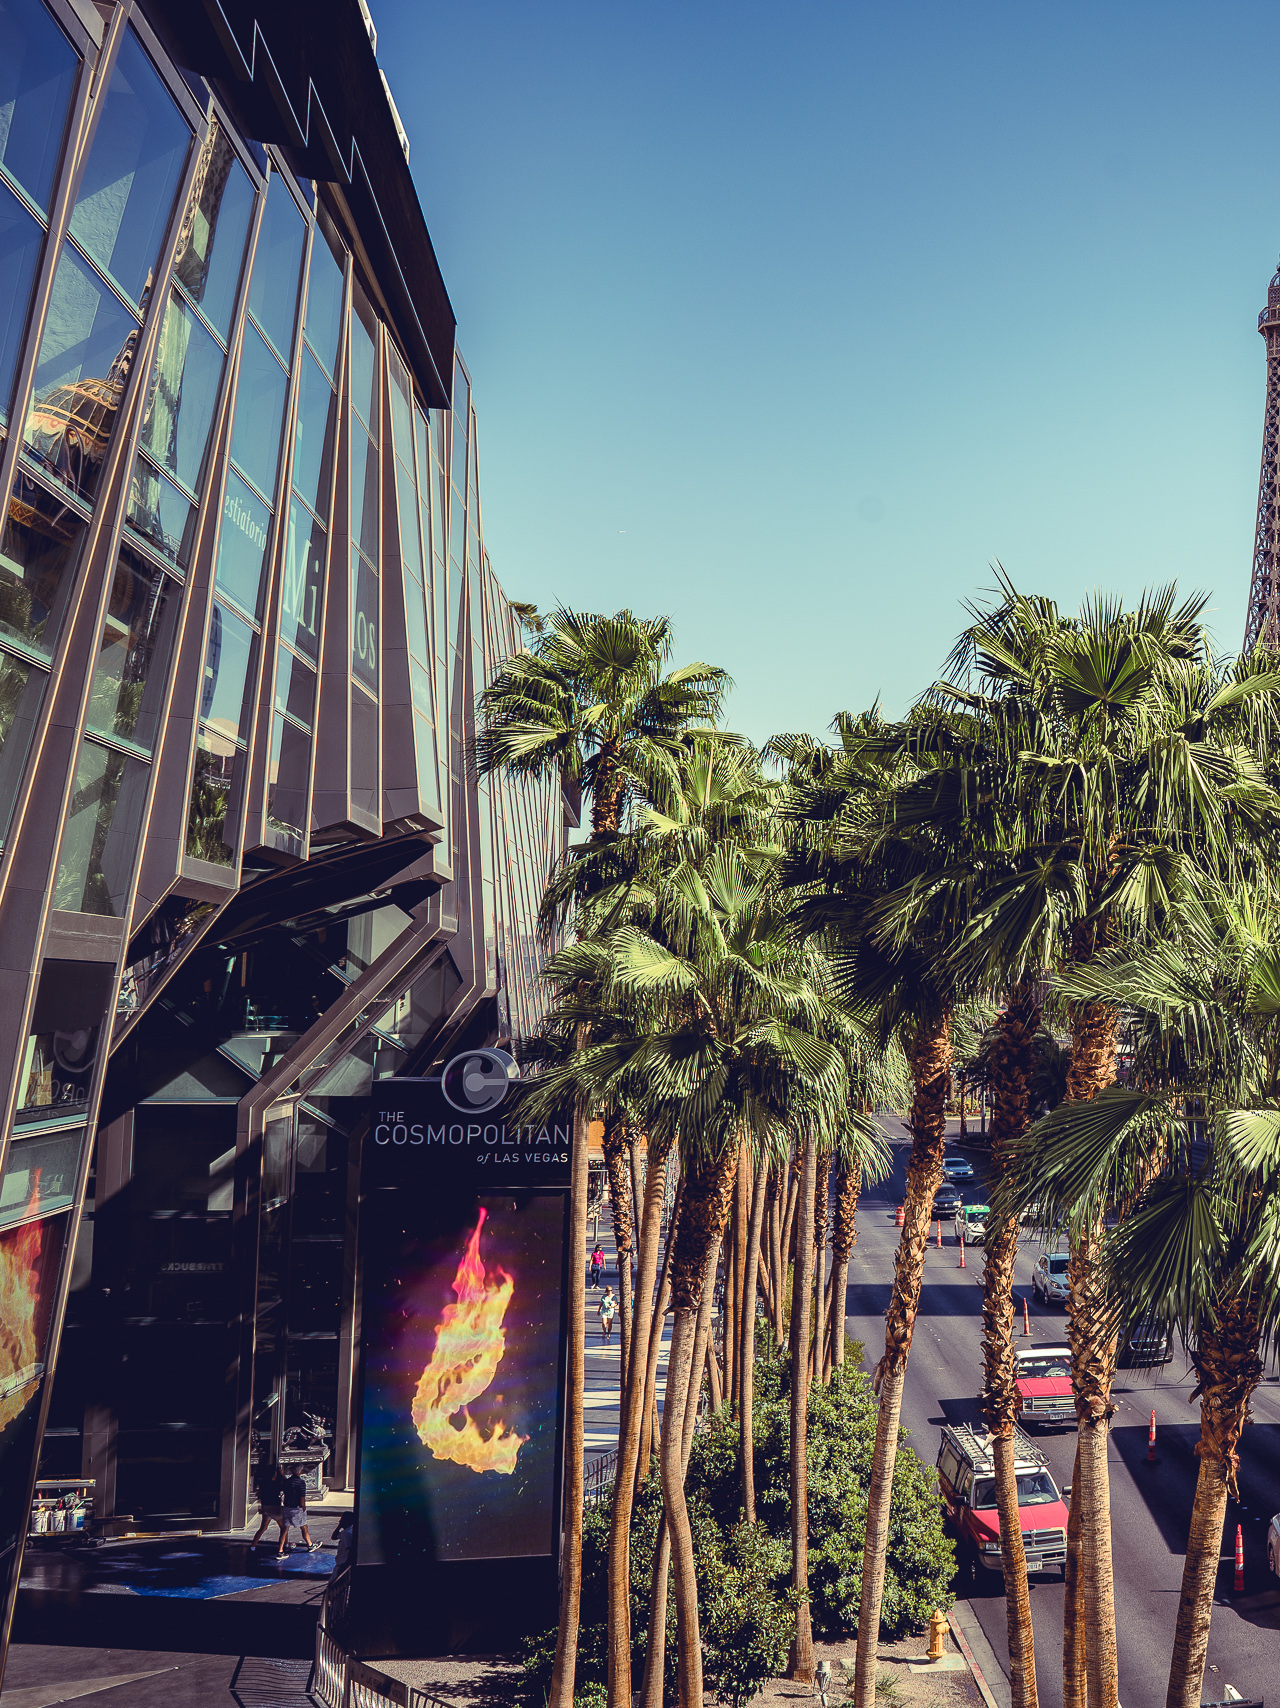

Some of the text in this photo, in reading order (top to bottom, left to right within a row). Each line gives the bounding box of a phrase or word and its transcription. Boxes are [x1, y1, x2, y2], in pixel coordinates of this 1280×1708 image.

[224, 496, 267, 552] estiatorio
[379, 1111, 404, 1122] THE
[374, 1124, 570, 1145] COSMOPOLITAN
[476, 1152, 569, 1165] of LAS VEGAS
